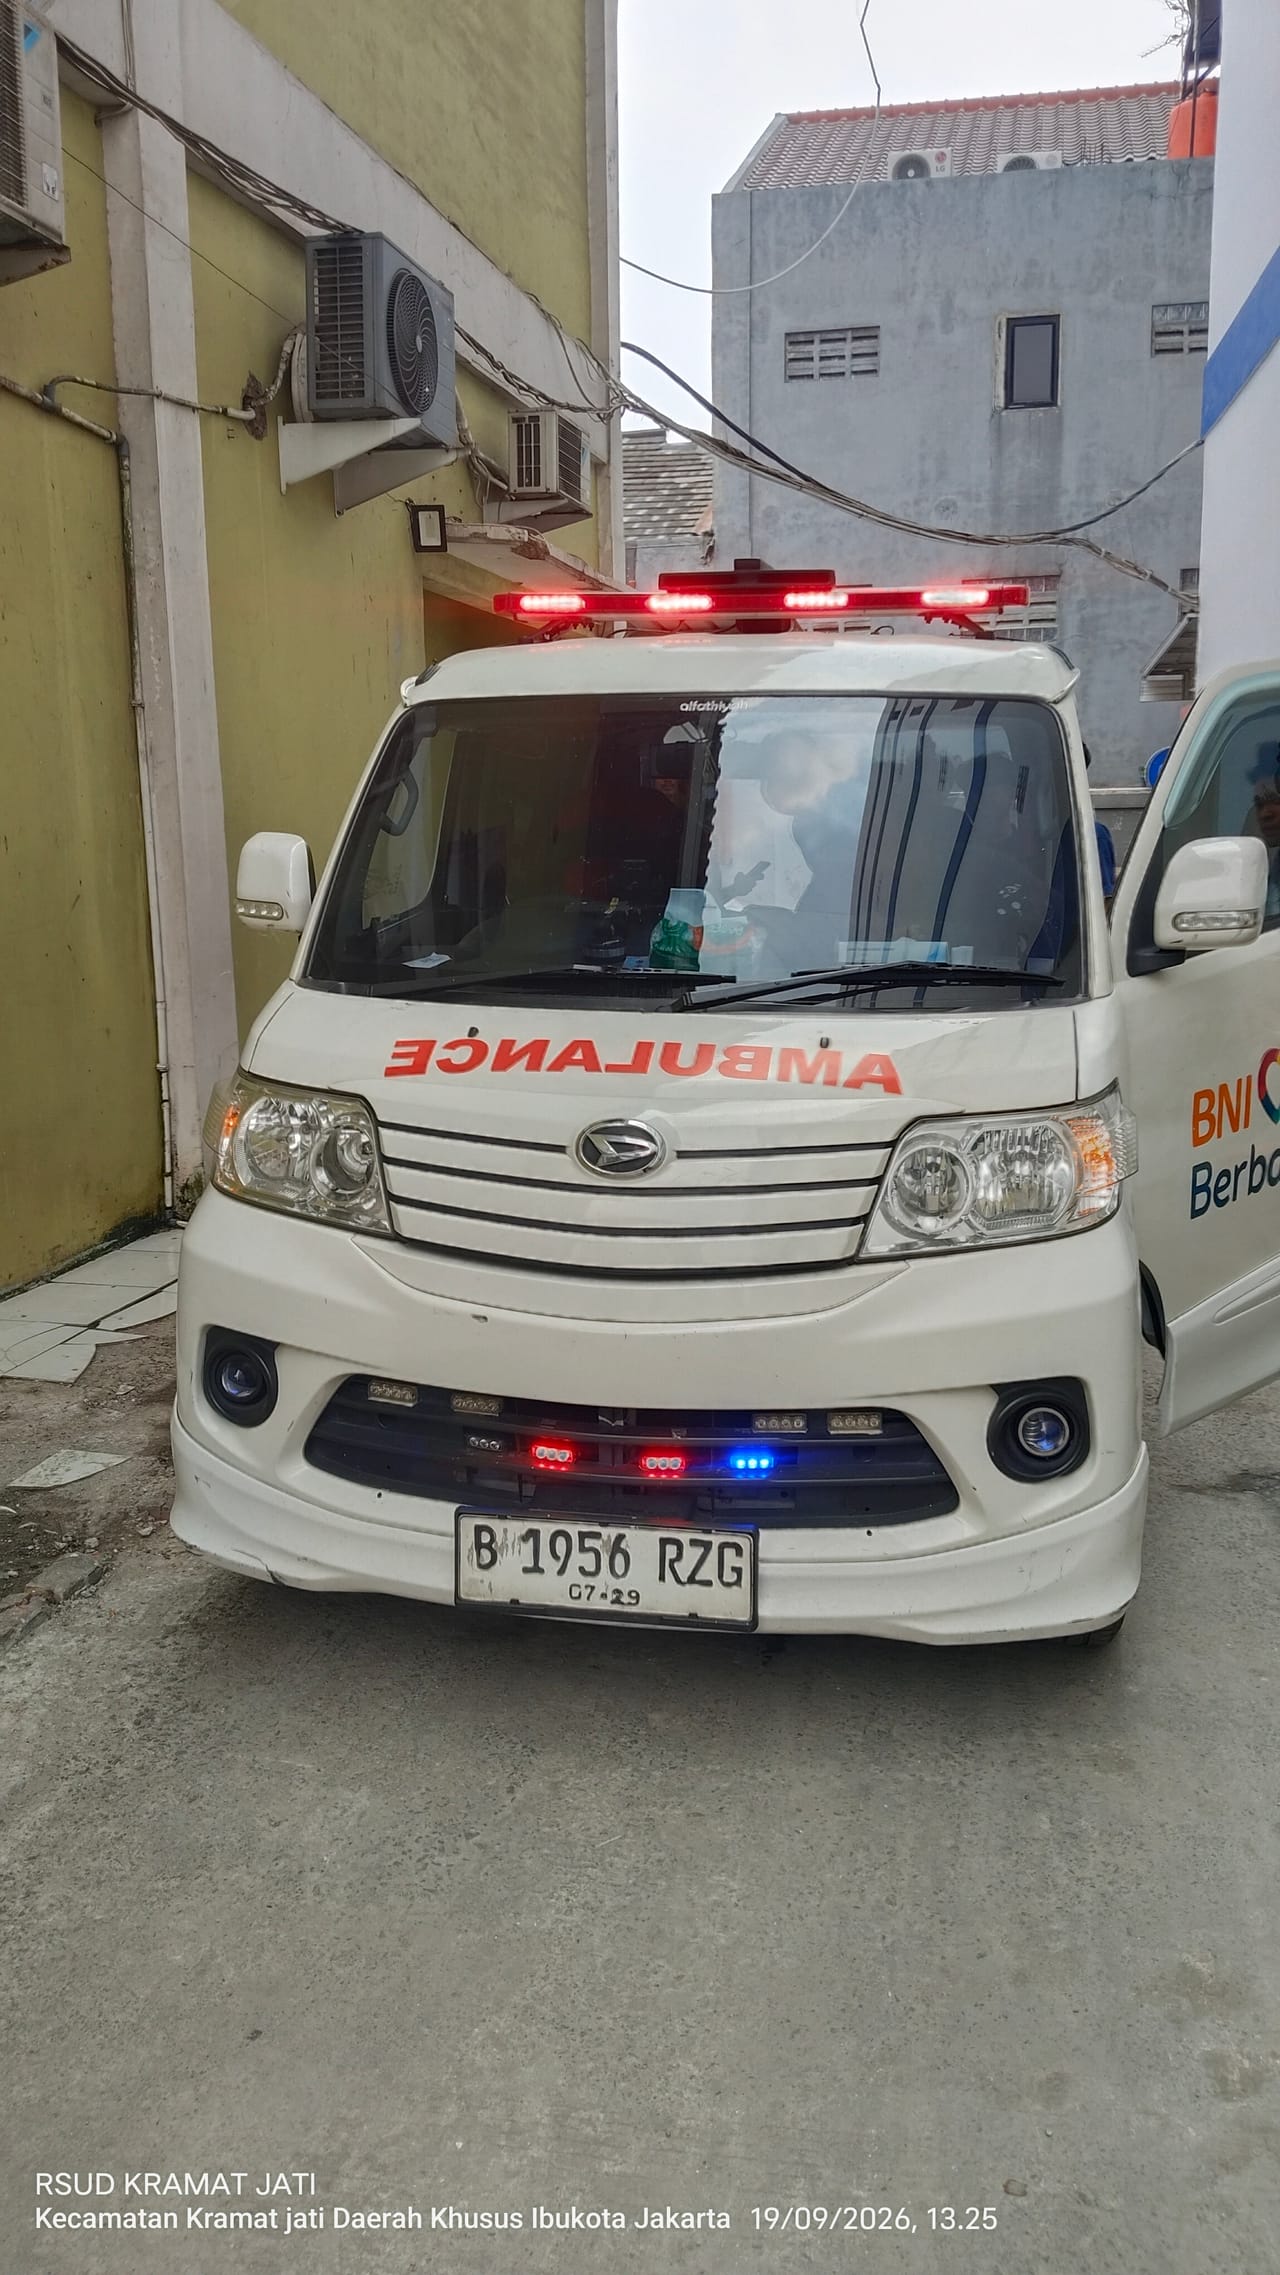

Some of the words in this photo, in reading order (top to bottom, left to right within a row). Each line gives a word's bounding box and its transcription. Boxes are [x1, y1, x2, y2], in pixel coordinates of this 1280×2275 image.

[935, 165, 946, 173] LG
[1192, 1074, 1252, 1147] BNI
[474, 1524, 498, 1570] B
[521, 1528, 631, 1579] 1956
[658, 1537, 744, 1588] RZG
